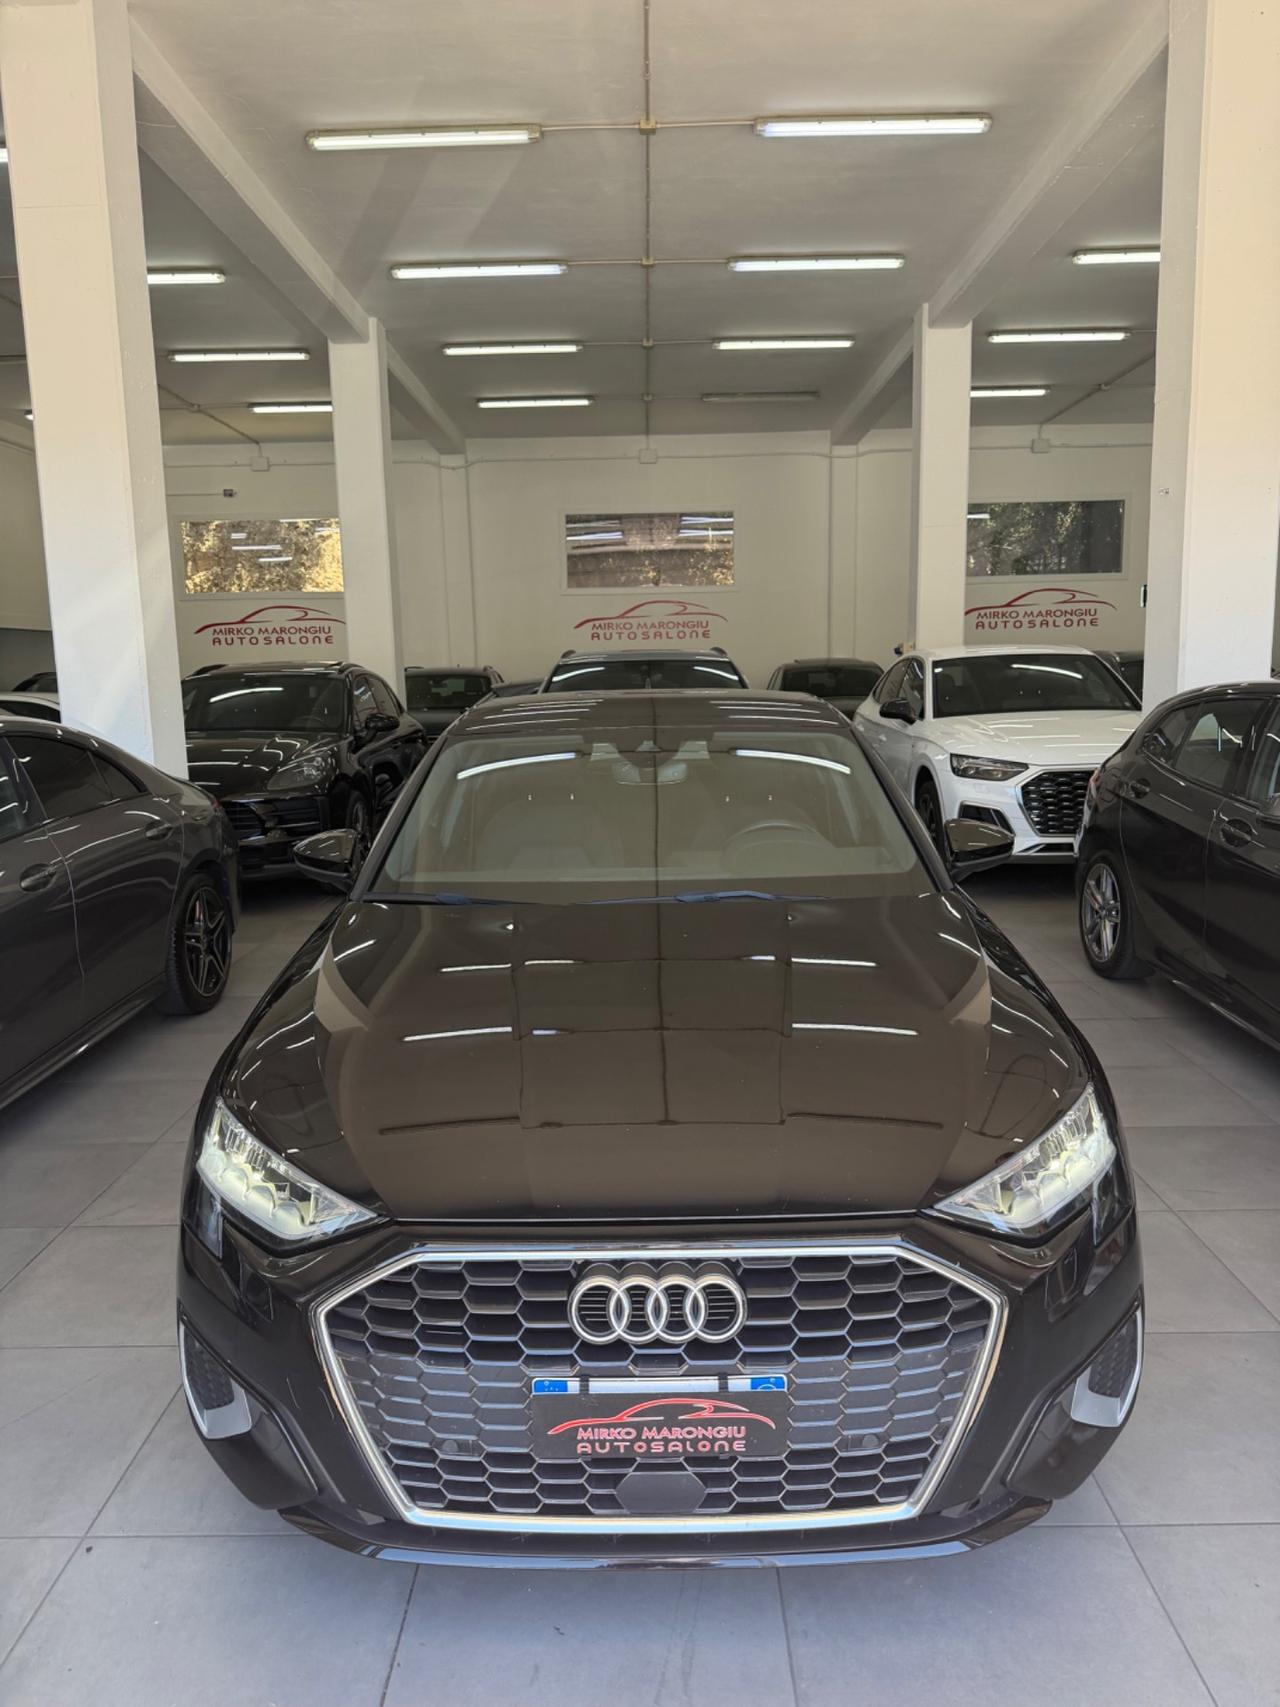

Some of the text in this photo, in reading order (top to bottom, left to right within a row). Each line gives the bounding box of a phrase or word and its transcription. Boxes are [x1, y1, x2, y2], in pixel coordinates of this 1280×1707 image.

[977, 608, 1097, 619] MIRKO MARONGIU
[592, 620, 709, 631] MIRKO MARONGIU
[975, 618, 1099, 630] AUTOSALONE
[212, 626, 331, 636] MIRKO MARONGIU
[591, 629, 711, 641] AUTOSALONE
[212, 635, 334, 646] AUTOSALONE
[577, 1426, 746, 1440] MIRKO MARONGIU
[577, 1440, 746, 1454] AUTOSALONE
